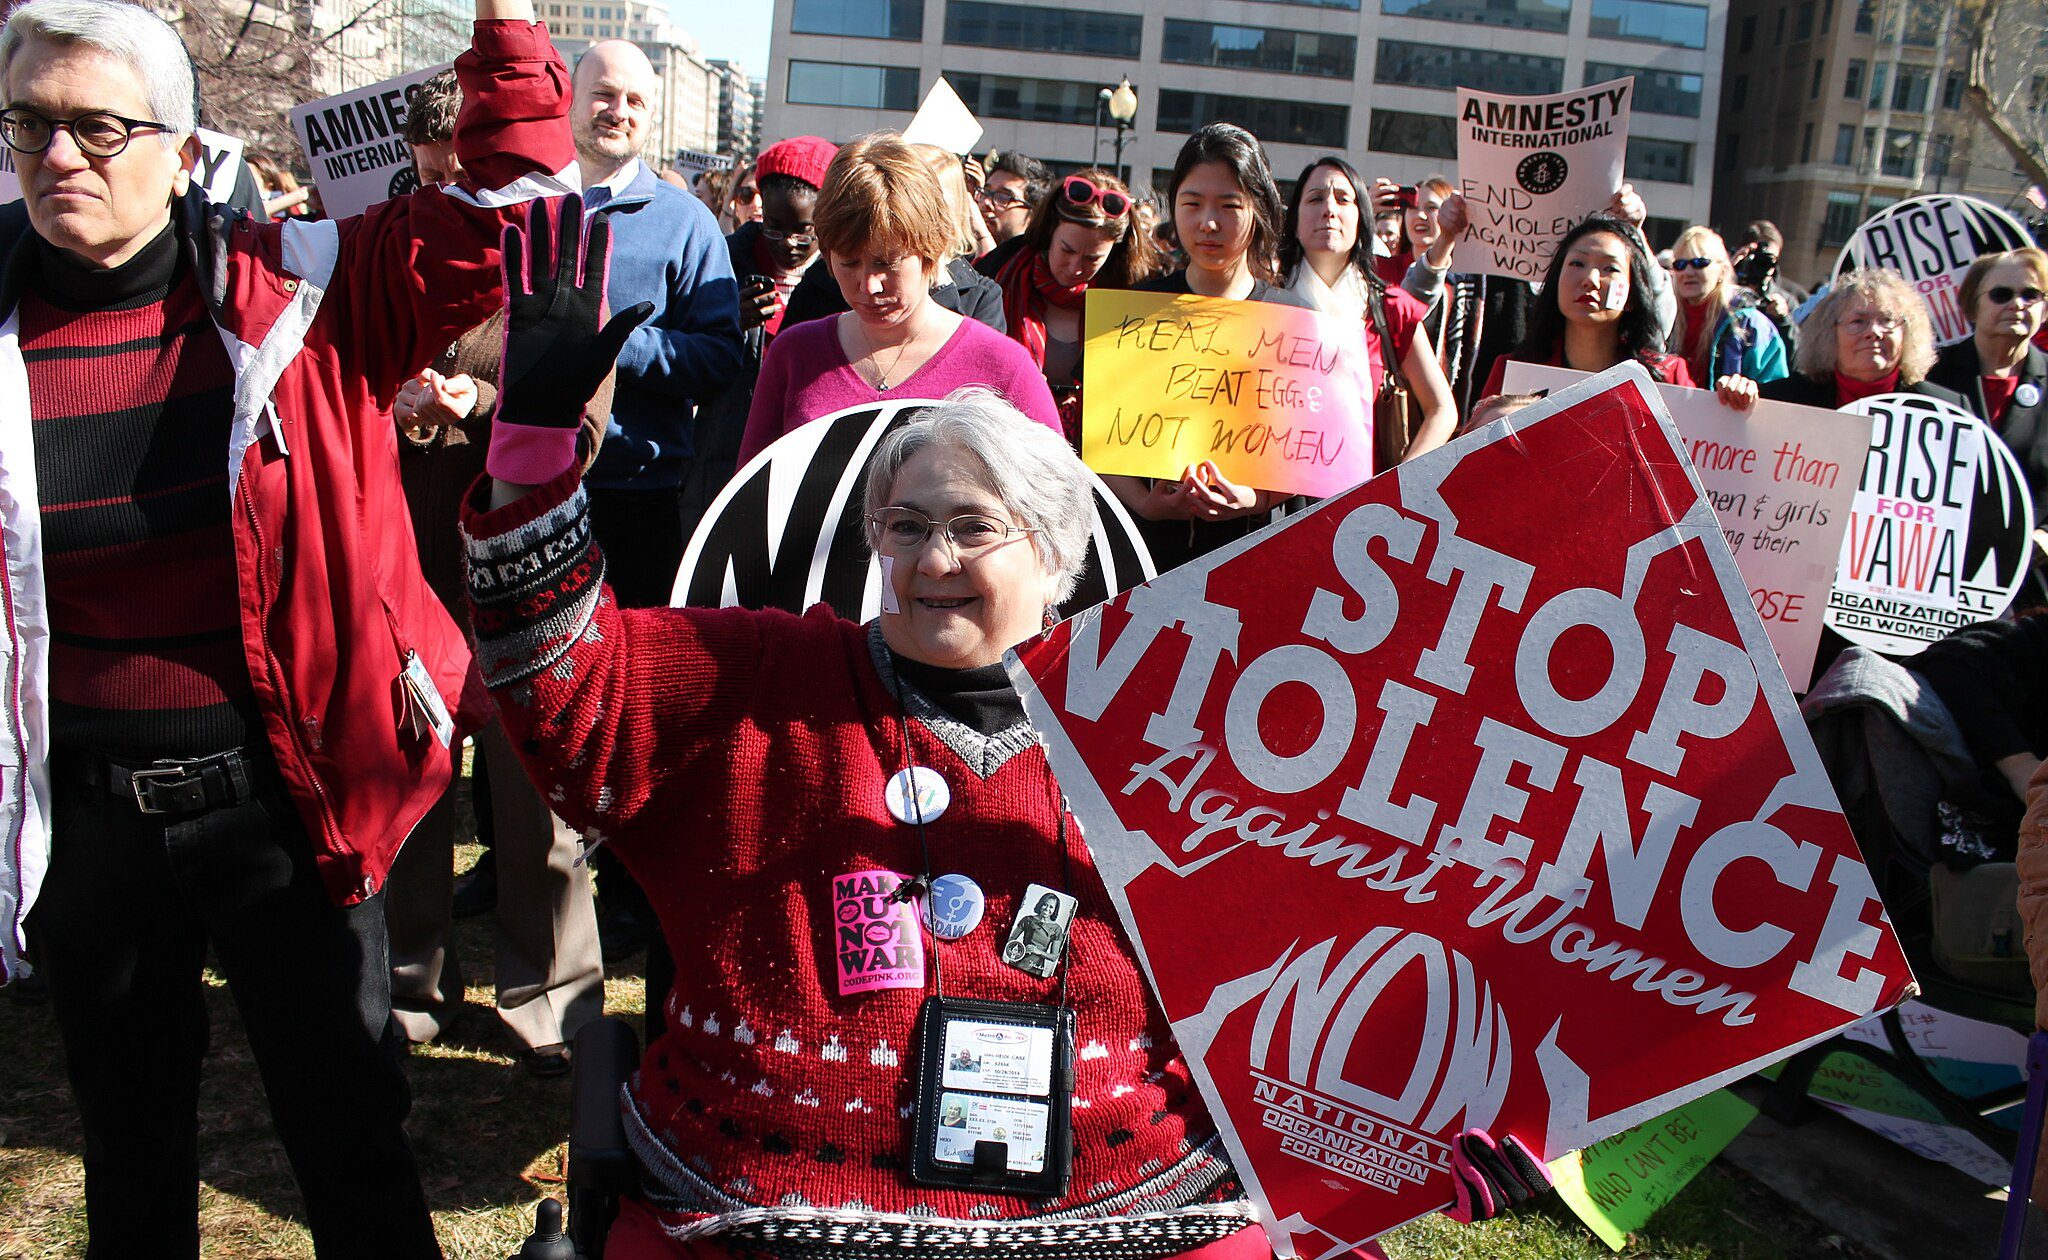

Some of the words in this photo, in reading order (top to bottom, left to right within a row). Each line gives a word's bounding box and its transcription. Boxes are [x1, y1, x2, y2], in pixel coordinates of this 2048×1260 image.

[305, 83, 424, 157] AMNE
[1462, 86, 1628, 132] AMNESTY
[1472, 121, 1613, 149] INTERNATIONAL
[325, 139, 411, 181] INTERNA
[678, 151, 732, 166] AMNESTY
[1462, 179, 1533, 210] END
[1464, 223, 1561, 258] AGAINS
[1866, 201, 1970, 281] RISE
[1494, 251, 1552, 277] WOM
[1917, 274, 1952, 294] OR
[1114, 314, 1229, 356] REAL
[1248, 328, 1340, 374] MEN
[1165, 363, 1251, 407] BEAT
[1107, 407, 1190, 449] NOT
[1210, 419, 1344, 466] WOMEN
[1859, 406, 1973, 510] RISE
[1692, 440, 1757, 474] more
[1773, 442, 1839, 489] than
[1767, 500, 1831, 532] girls
[1876, 498, 1936, 523] FOR
[1753, 529, 1799, 554] their
[1850, 512, 1955, 598] VAWA
[1751, 588, 1805, 623] OSE
[1831, 591, 1977, 627] RGANIZATION
[1836, 611, 1871, 627] FOR
[1302, 503, 1757, 777] STOP
[1065, 587, 1891, 1017] VIOLENCE
[835, 876, 897, 901] MAK
[1121, 740, 1457, 903] Against
[1467, 857, 1757, 1027] Women
[838, 920, 914, 952] NOT
[839, 946, 919, 976] WAR
[843, 972, 920, 988] CODEPINK.ORG
[1250, 926, 1512, 1135] NOW
[1254, 1080, 1452, 1168] NATIONAL
[1263, 1109, 1430, 1181] ORGANIZATION
[1280, 1136, 1320, 1160] FOR
[1325, 1151, 1402, 1189] WOMEN
[1585, 1172, 1633, 1212] WHO
[1624, 1133, 1675, 1179] CAN'T
[1664, 1112, 1698, 1145] BE!
